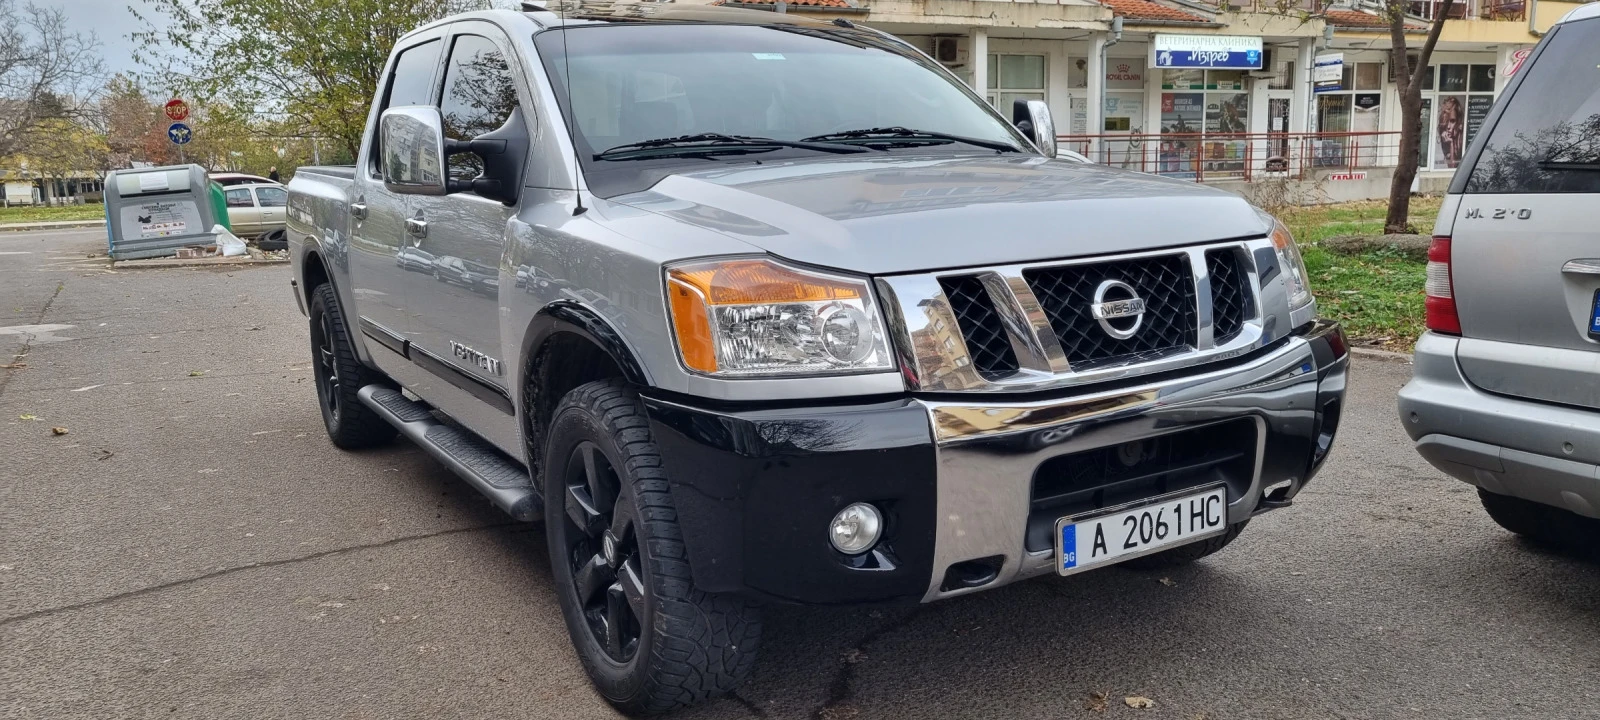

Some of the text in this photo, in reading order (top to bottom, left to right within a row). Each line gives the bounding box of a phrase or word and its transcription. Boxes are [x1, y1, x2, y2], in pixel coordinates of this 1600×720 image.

[1159, 37, 1257, 47] ВЕТЕРИНАРНА КЛИНИКА
[166, 105, 187, 116] STOP
[1101, 302, 1144, 316] NISSAN
[1063, 551, 1075, 564] BG
[1091, 522, 1108, 558] A
